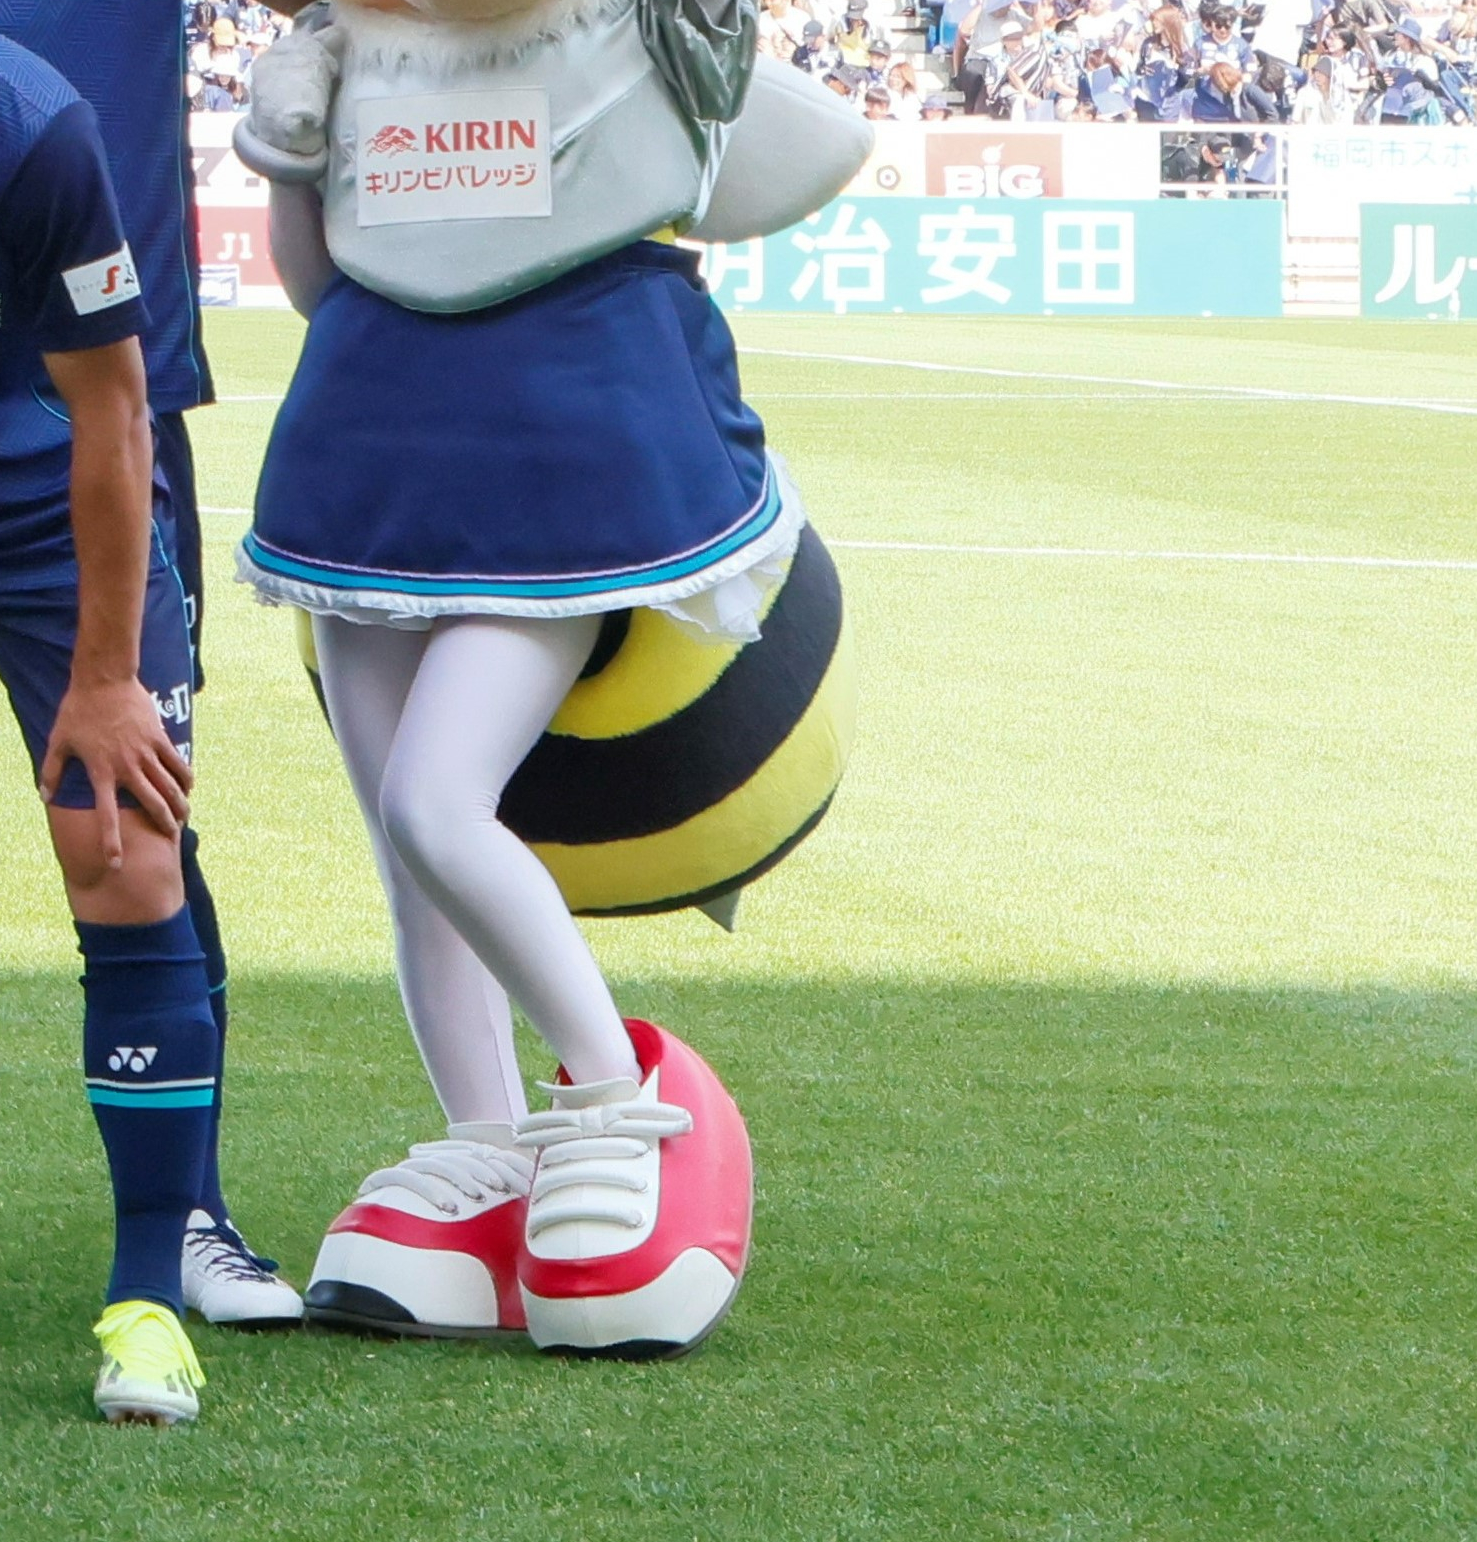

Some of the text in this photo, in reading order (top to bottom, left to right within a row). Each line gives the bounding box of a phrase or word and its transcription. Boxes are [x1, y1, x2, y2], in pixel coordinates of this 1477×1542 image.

[424, 119, 536, 154] KIRIN
[365, 162, 537, 196] キリンビバレッジ
[1374, 224, 1477, 304] ル
